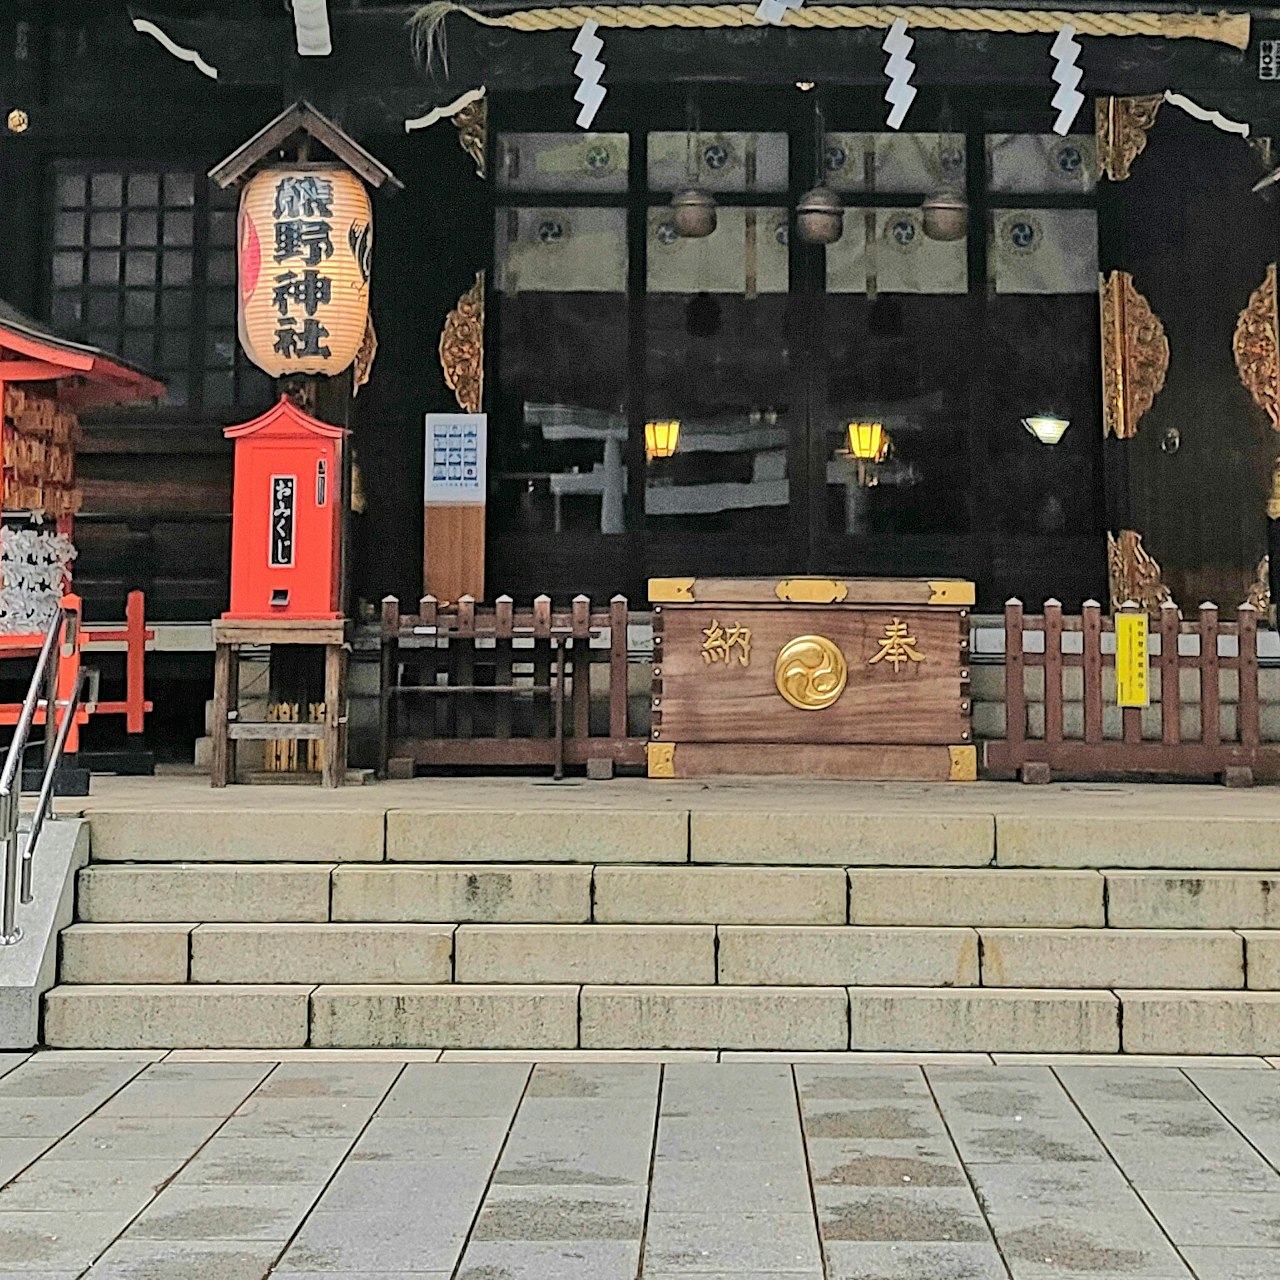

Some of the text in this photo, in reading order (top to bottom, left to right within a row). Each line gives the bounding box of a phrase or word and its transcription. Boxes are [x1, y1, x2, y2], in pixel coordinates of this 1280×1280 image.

[271, 176, 335, 360] 熊野神社
[273, 479, 293, 563] おみくじ
[700, 616, 927, 674] 奉 納
